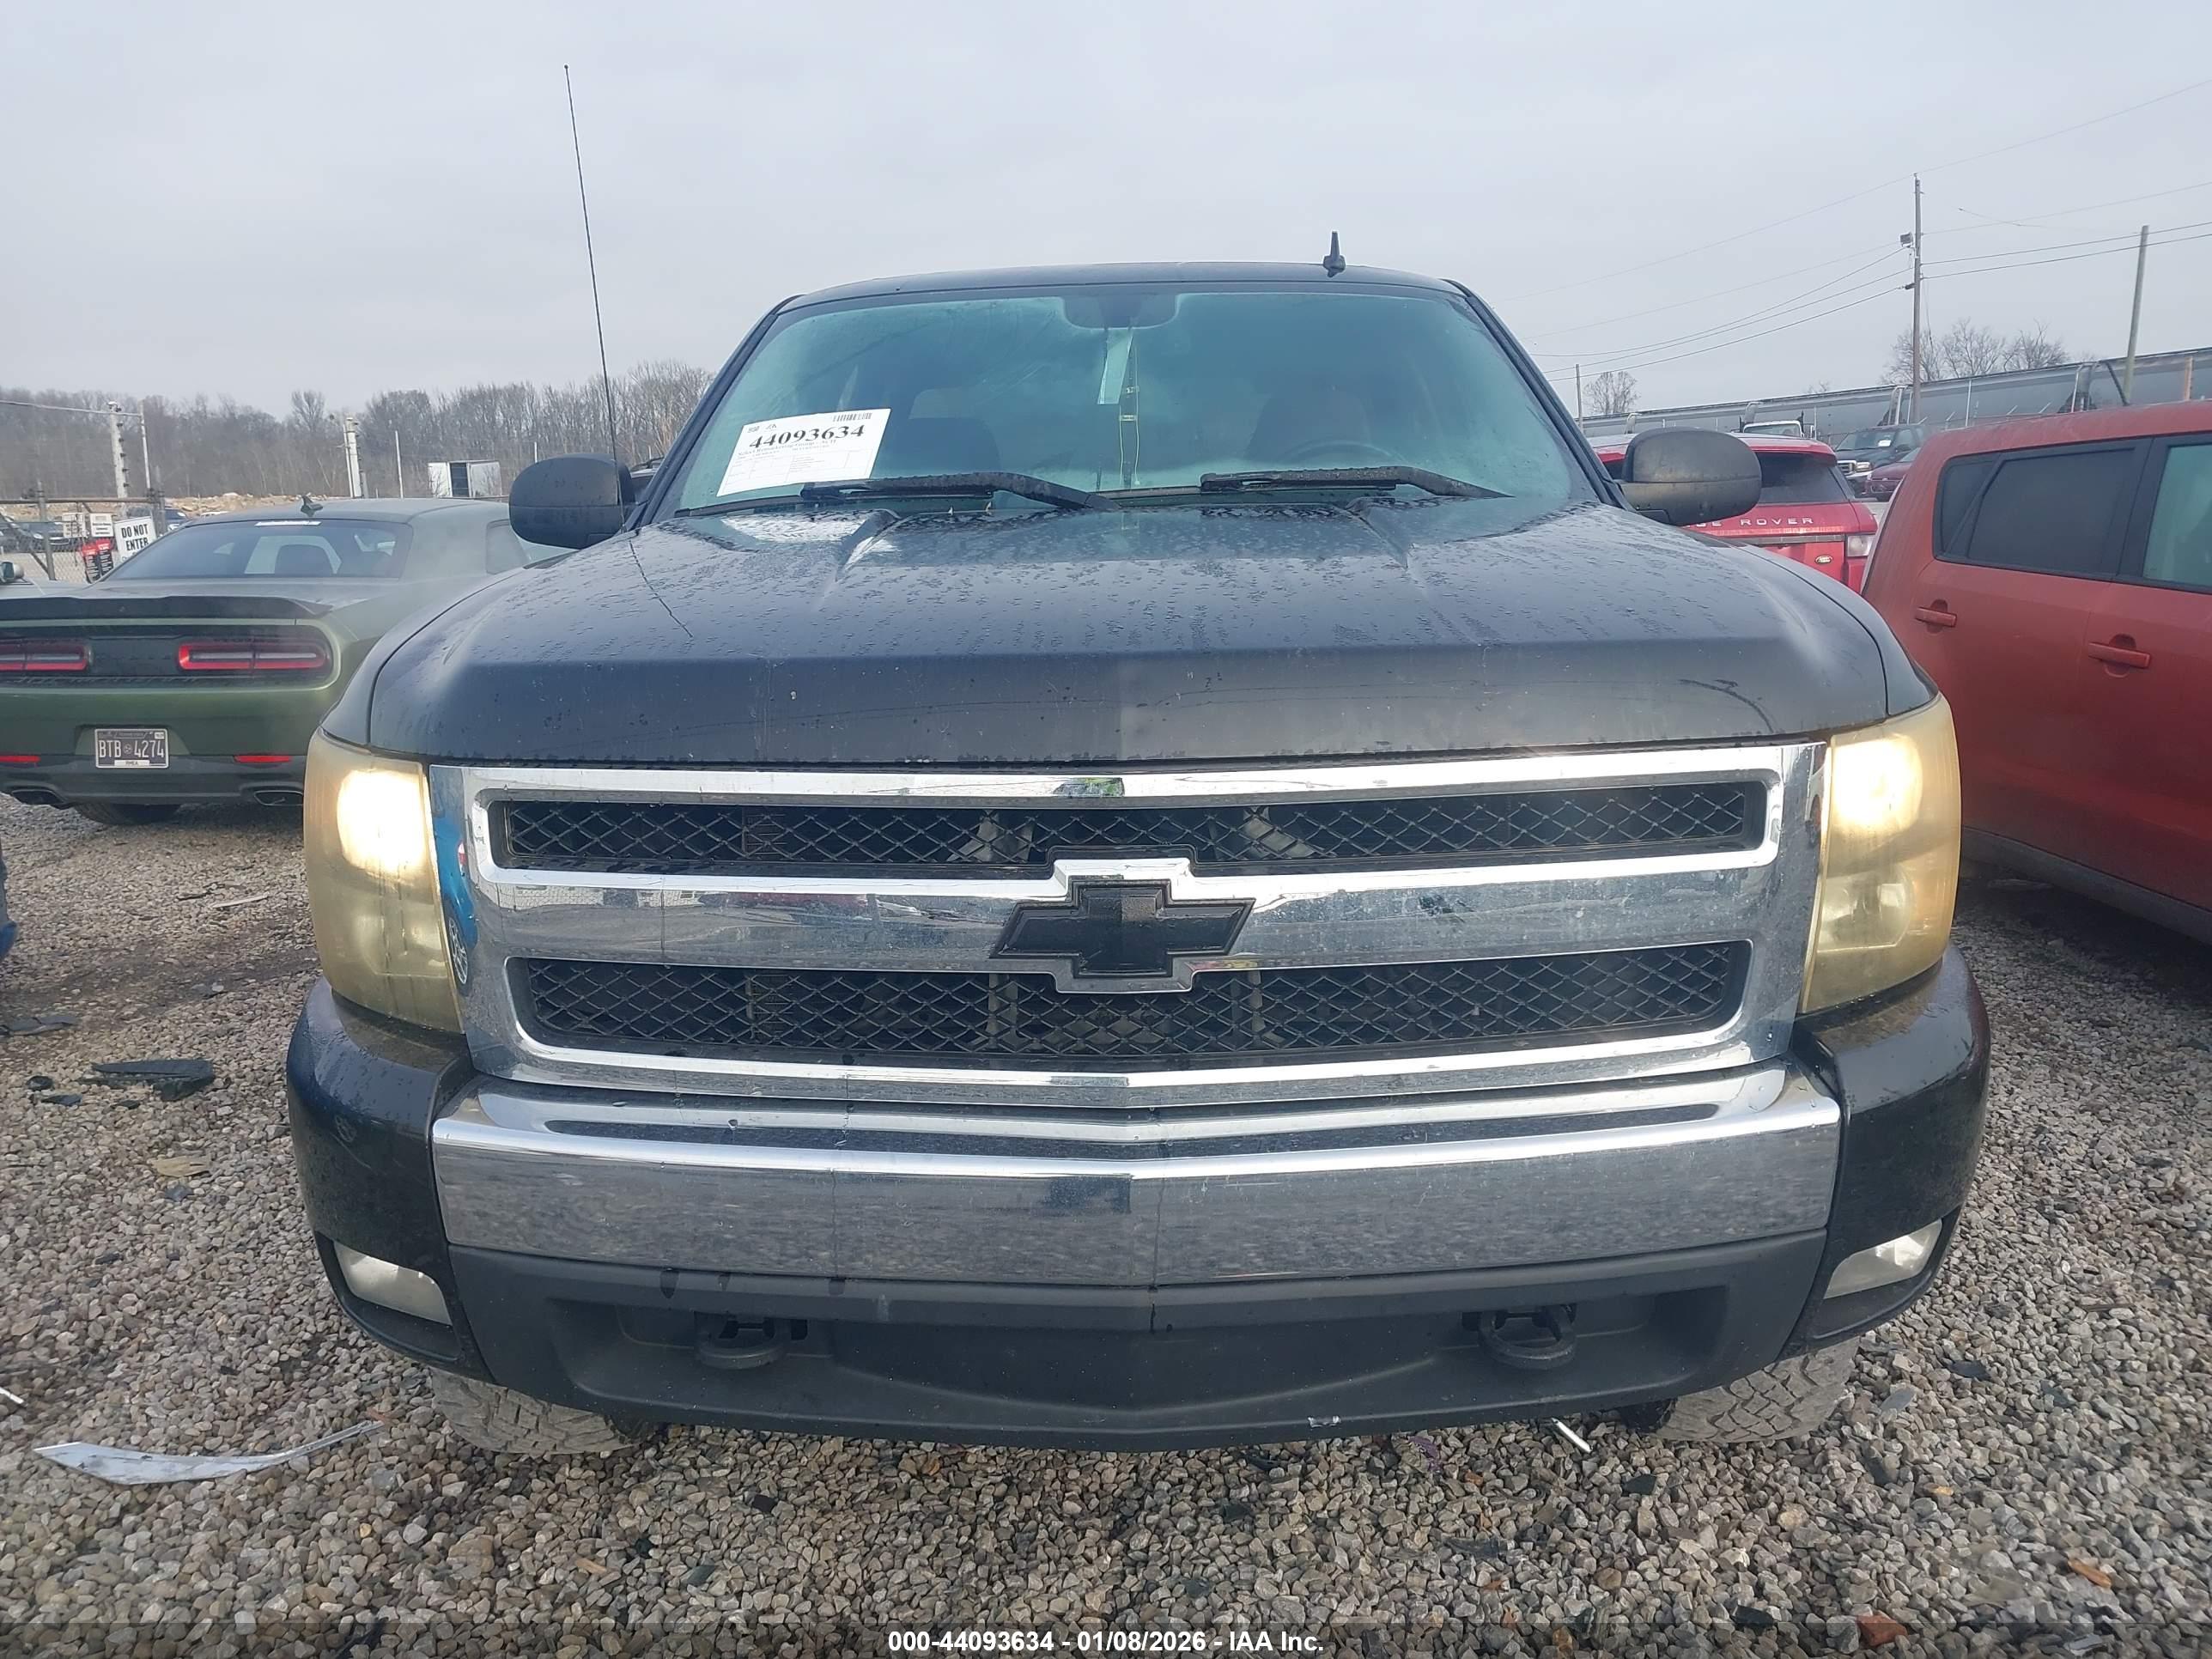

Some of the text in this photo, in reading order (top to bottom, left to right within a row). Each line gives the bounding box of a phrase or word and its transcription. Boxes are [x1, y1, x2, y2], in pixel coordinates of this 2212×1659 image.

[749, 424, 865, 448] 44093634
[1740, 517, 1814, 526] ROVER
[121, 524, 149, 538] DO NOT
[126, 538, 149, 550] ENTER
[99, 740, 164, 757] BTB 4274
